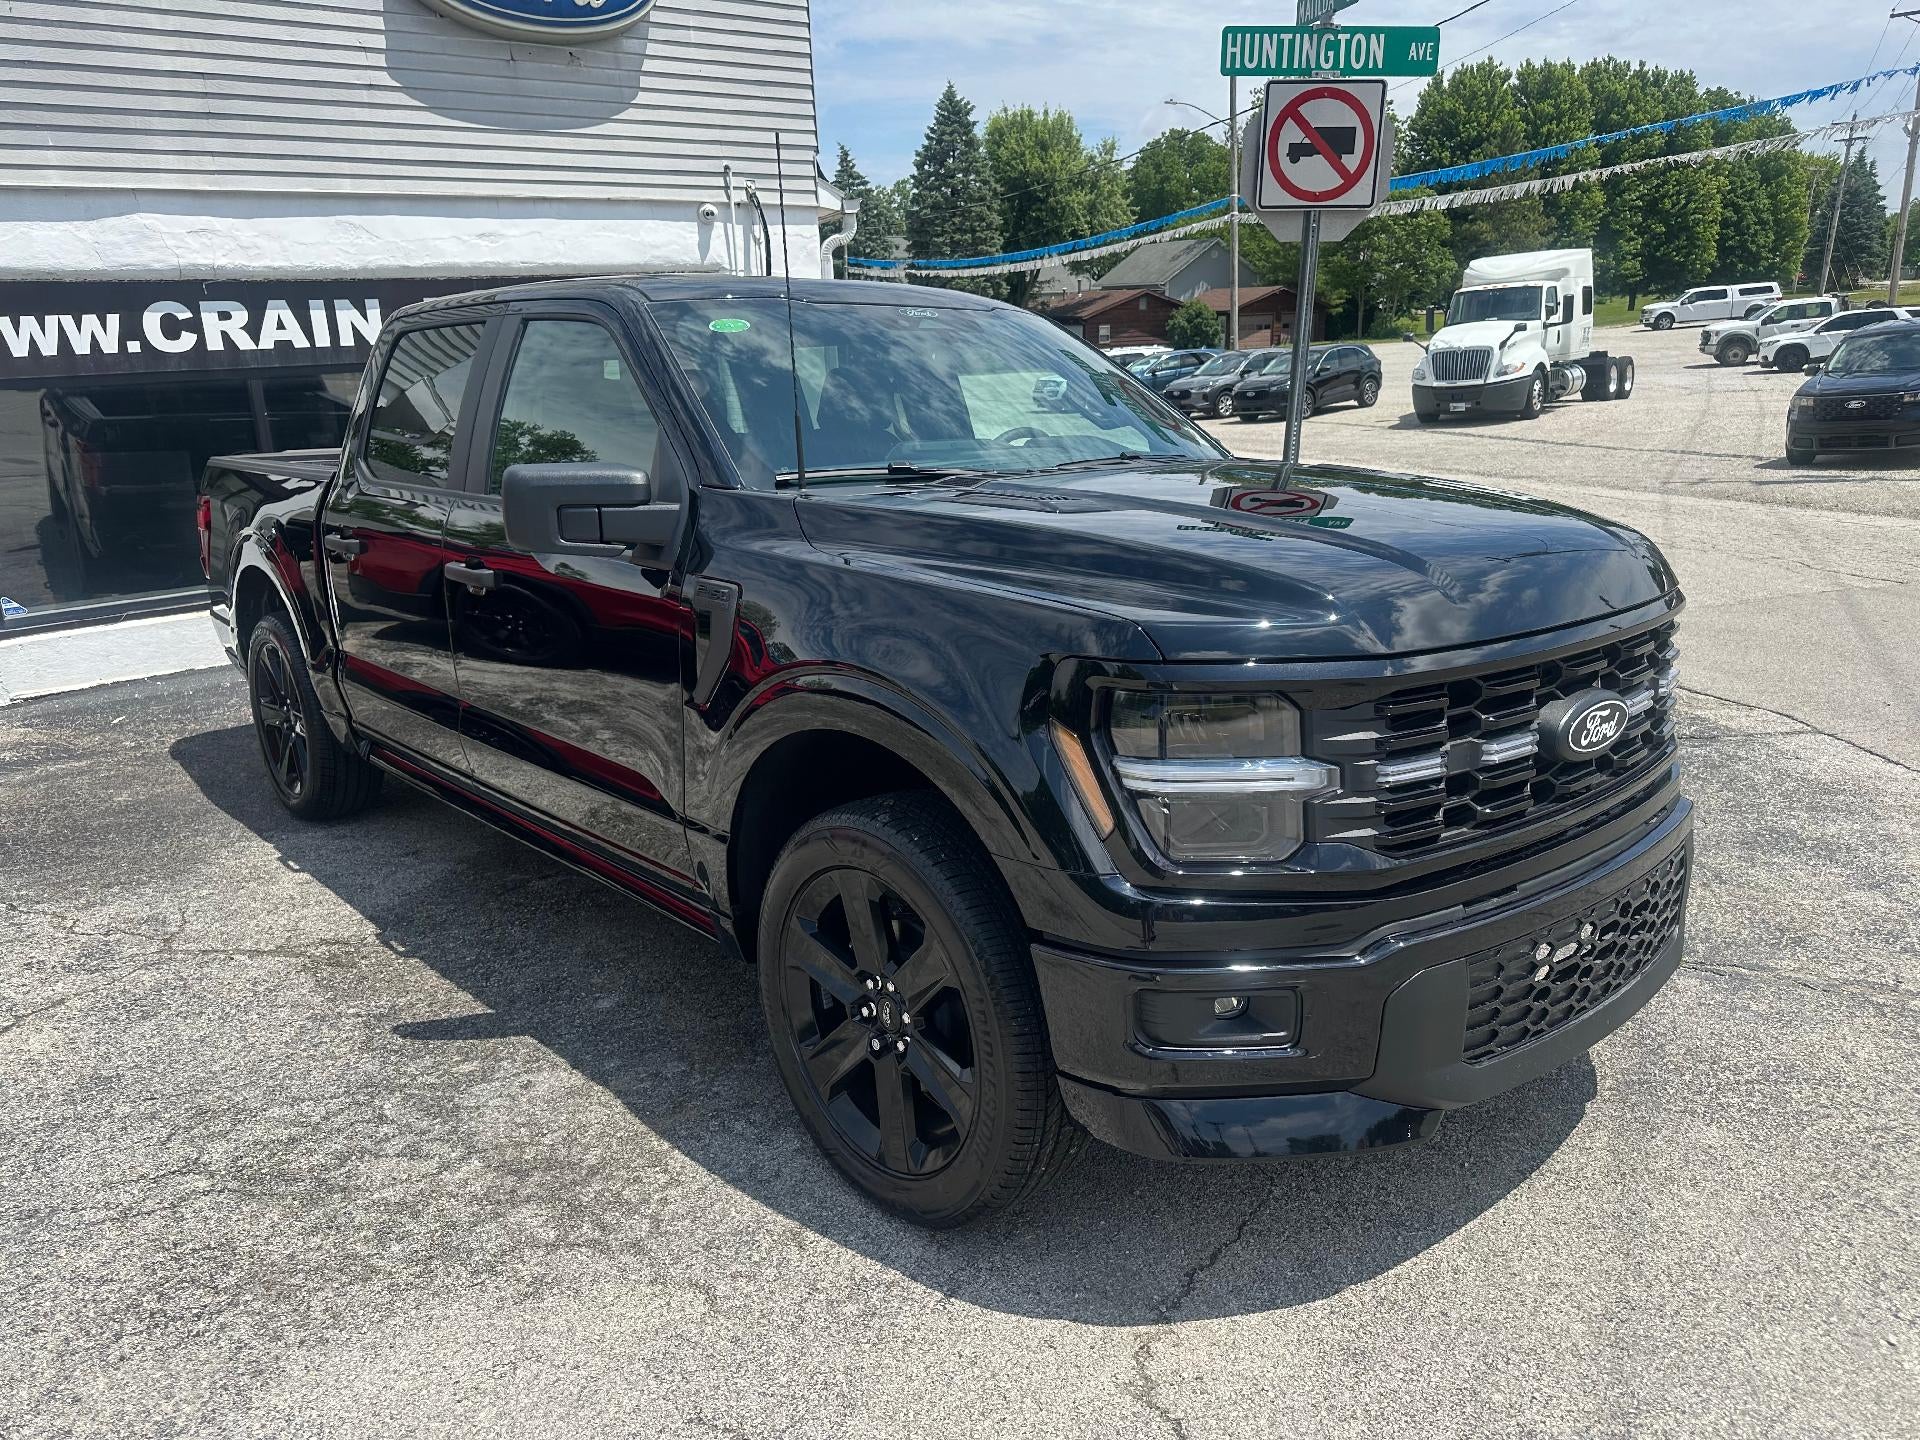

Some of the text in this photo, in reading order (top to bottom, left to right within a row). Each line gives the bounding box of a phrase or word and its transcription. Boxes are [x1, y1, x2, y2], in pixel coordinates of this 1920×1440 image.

[1225, 32, 1434, 69] HUNTINGTON AVE
[1580, 708, 1619, 747] Ford
